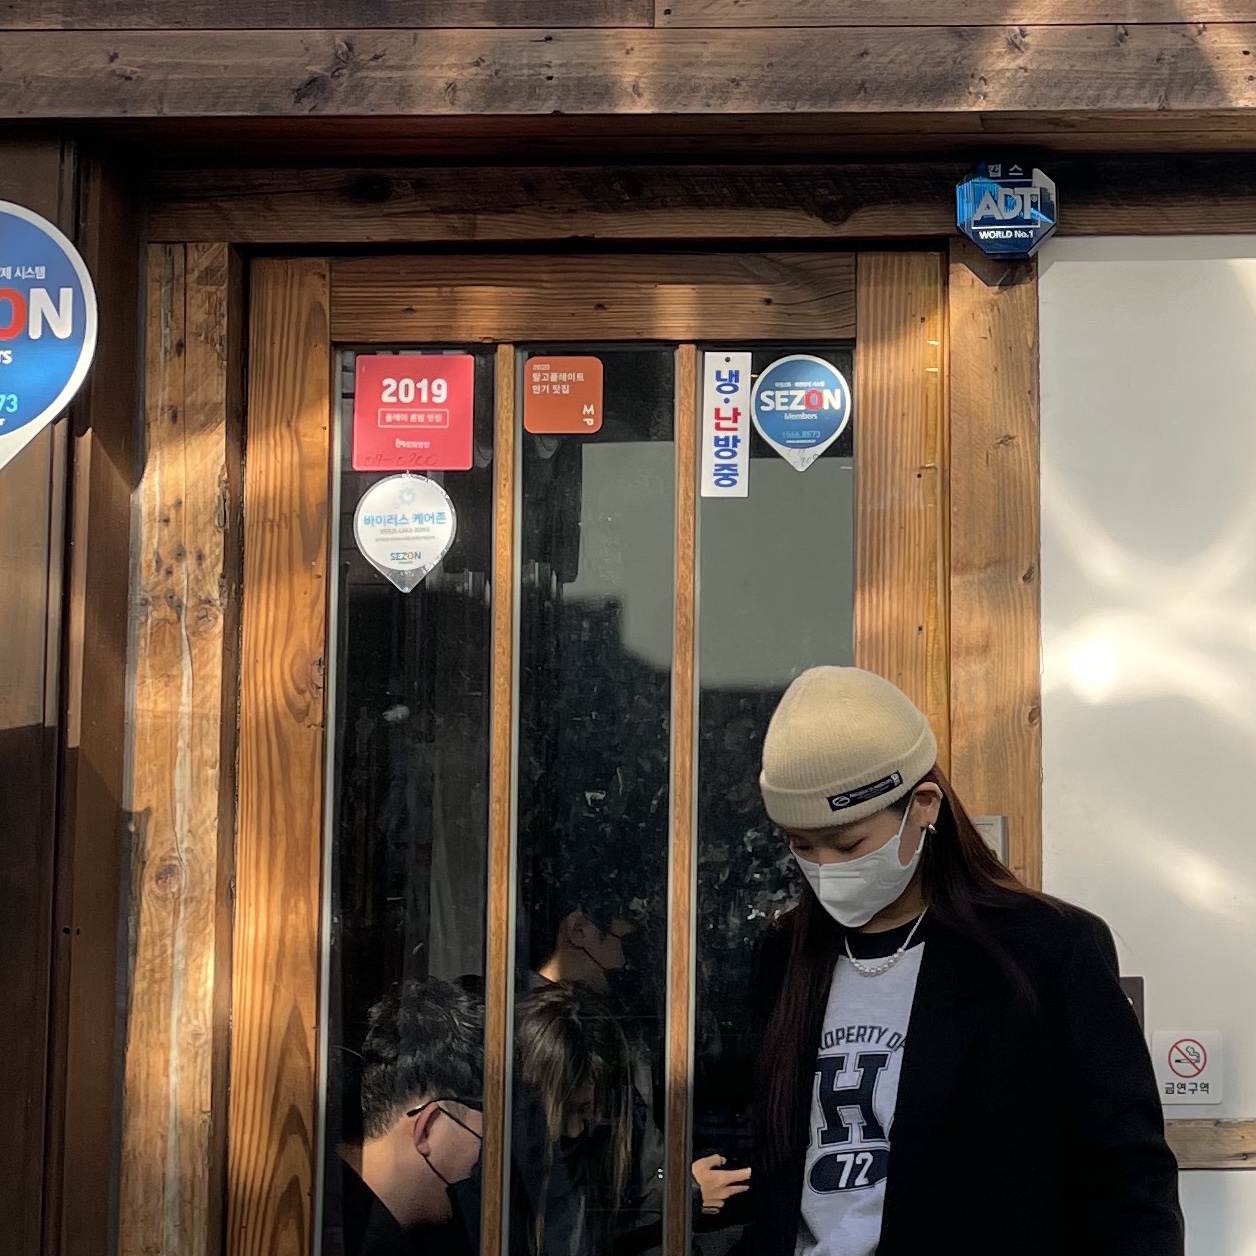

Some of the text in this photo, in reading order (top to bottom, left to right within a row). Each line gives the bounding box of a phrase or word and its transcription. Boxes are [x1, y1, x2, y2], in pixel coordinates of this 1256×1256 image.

[979, 229, 1033, 239] WORLD No.1
[15, 265, 46, 279] 시스템
[381, 378, 448, 404] 2019
[532, 384, 569, 394] 인기 맛집
[760, 388, 841, 411] SEZON
[364, 512, 446, 526] 바이러스 케어존
[820, 1025, 888, 1051] OPERTY
[1165, 1082, 1209, 1095] 금연구역
[815, 1051, 892, 1148] H
[836, 1152, 873, 1188] 72
